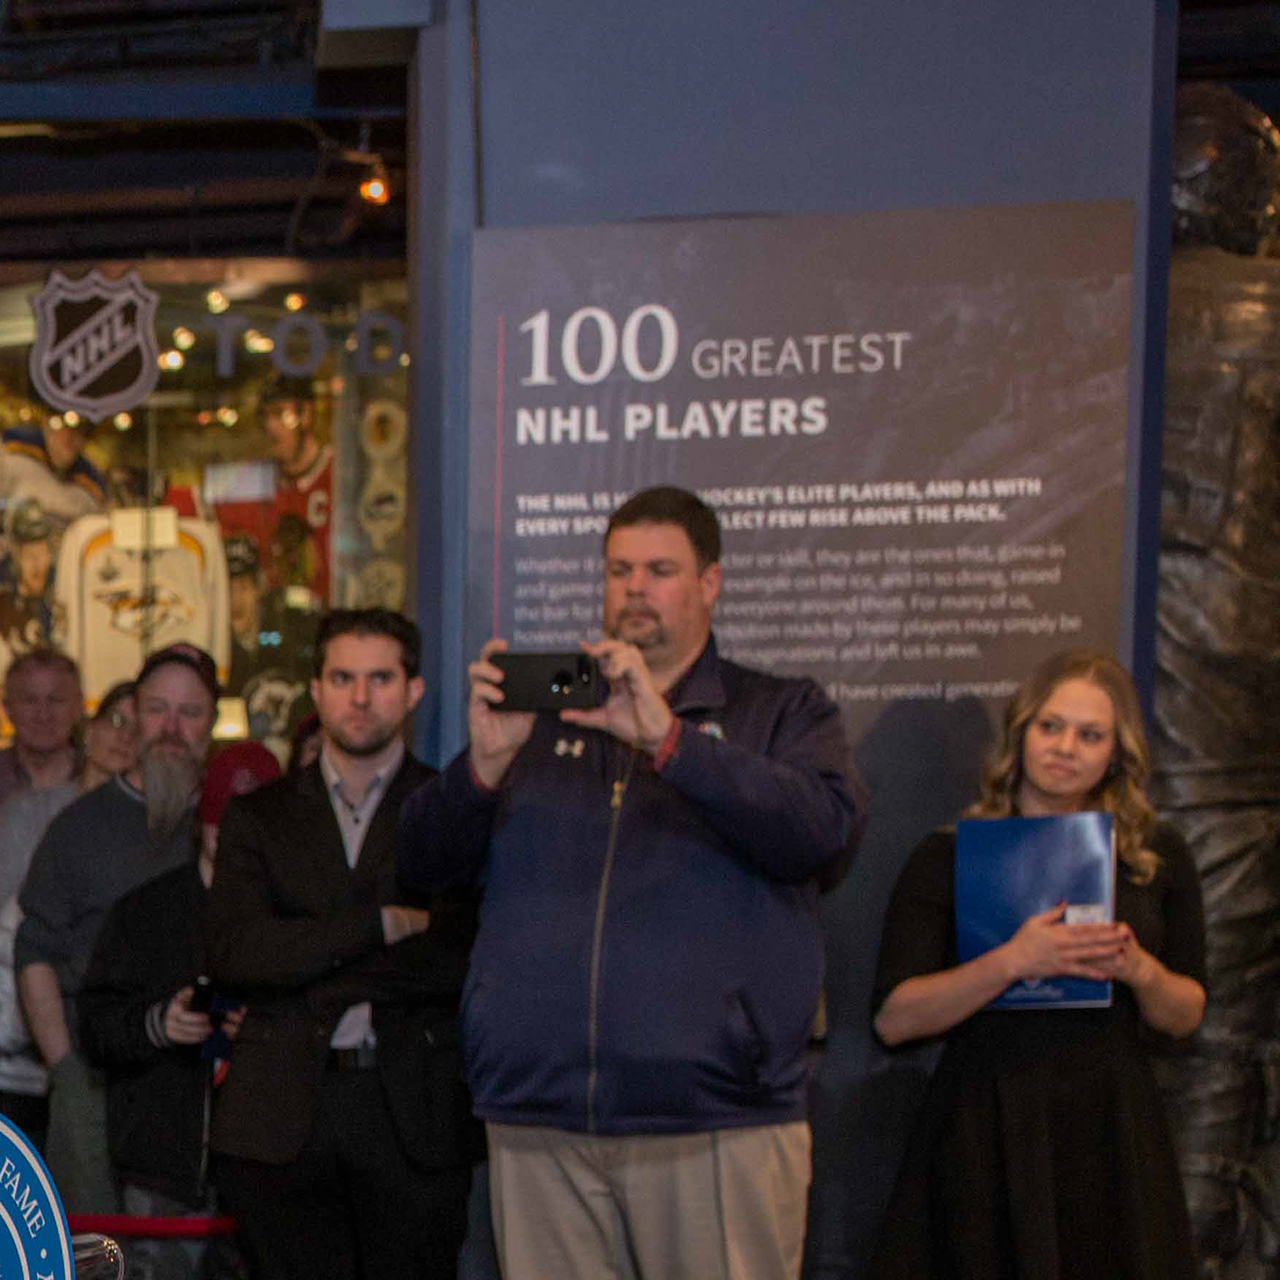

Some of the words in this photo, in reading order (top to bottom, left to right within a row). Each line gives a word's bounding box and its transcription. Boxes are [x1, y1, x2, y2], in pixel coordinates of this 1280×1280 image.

[58, 309, 135, 389] NHL
[519, 304, 679, 386] 100
[691, 331, 912, 379] GREATEST
[516, 405, 610, 445] NHL
[624, 396, 828, 442] PLAYERS
[516, 494, 551, 513] THE
[788, 483, 837, 504] ELITE
[839, 481, 923, 502] PLAYERS,
[925, 479, 964, 500] AND
[966, 479, 990, 499] AS
[992, 478, 1042, 497] WITH
[515, 516, 571, 537] EVERY
[572, 515, 608, 535] SPO
[720, 510, 767, 531] LECT
[768, 508, 807, 528] FEW
[809, 507, 849, 527] RISE
[851, 505, 913, 526] ABOVE
[915, 504, 951, 524] THE
[953, 502, 1007, 523] PACK.
